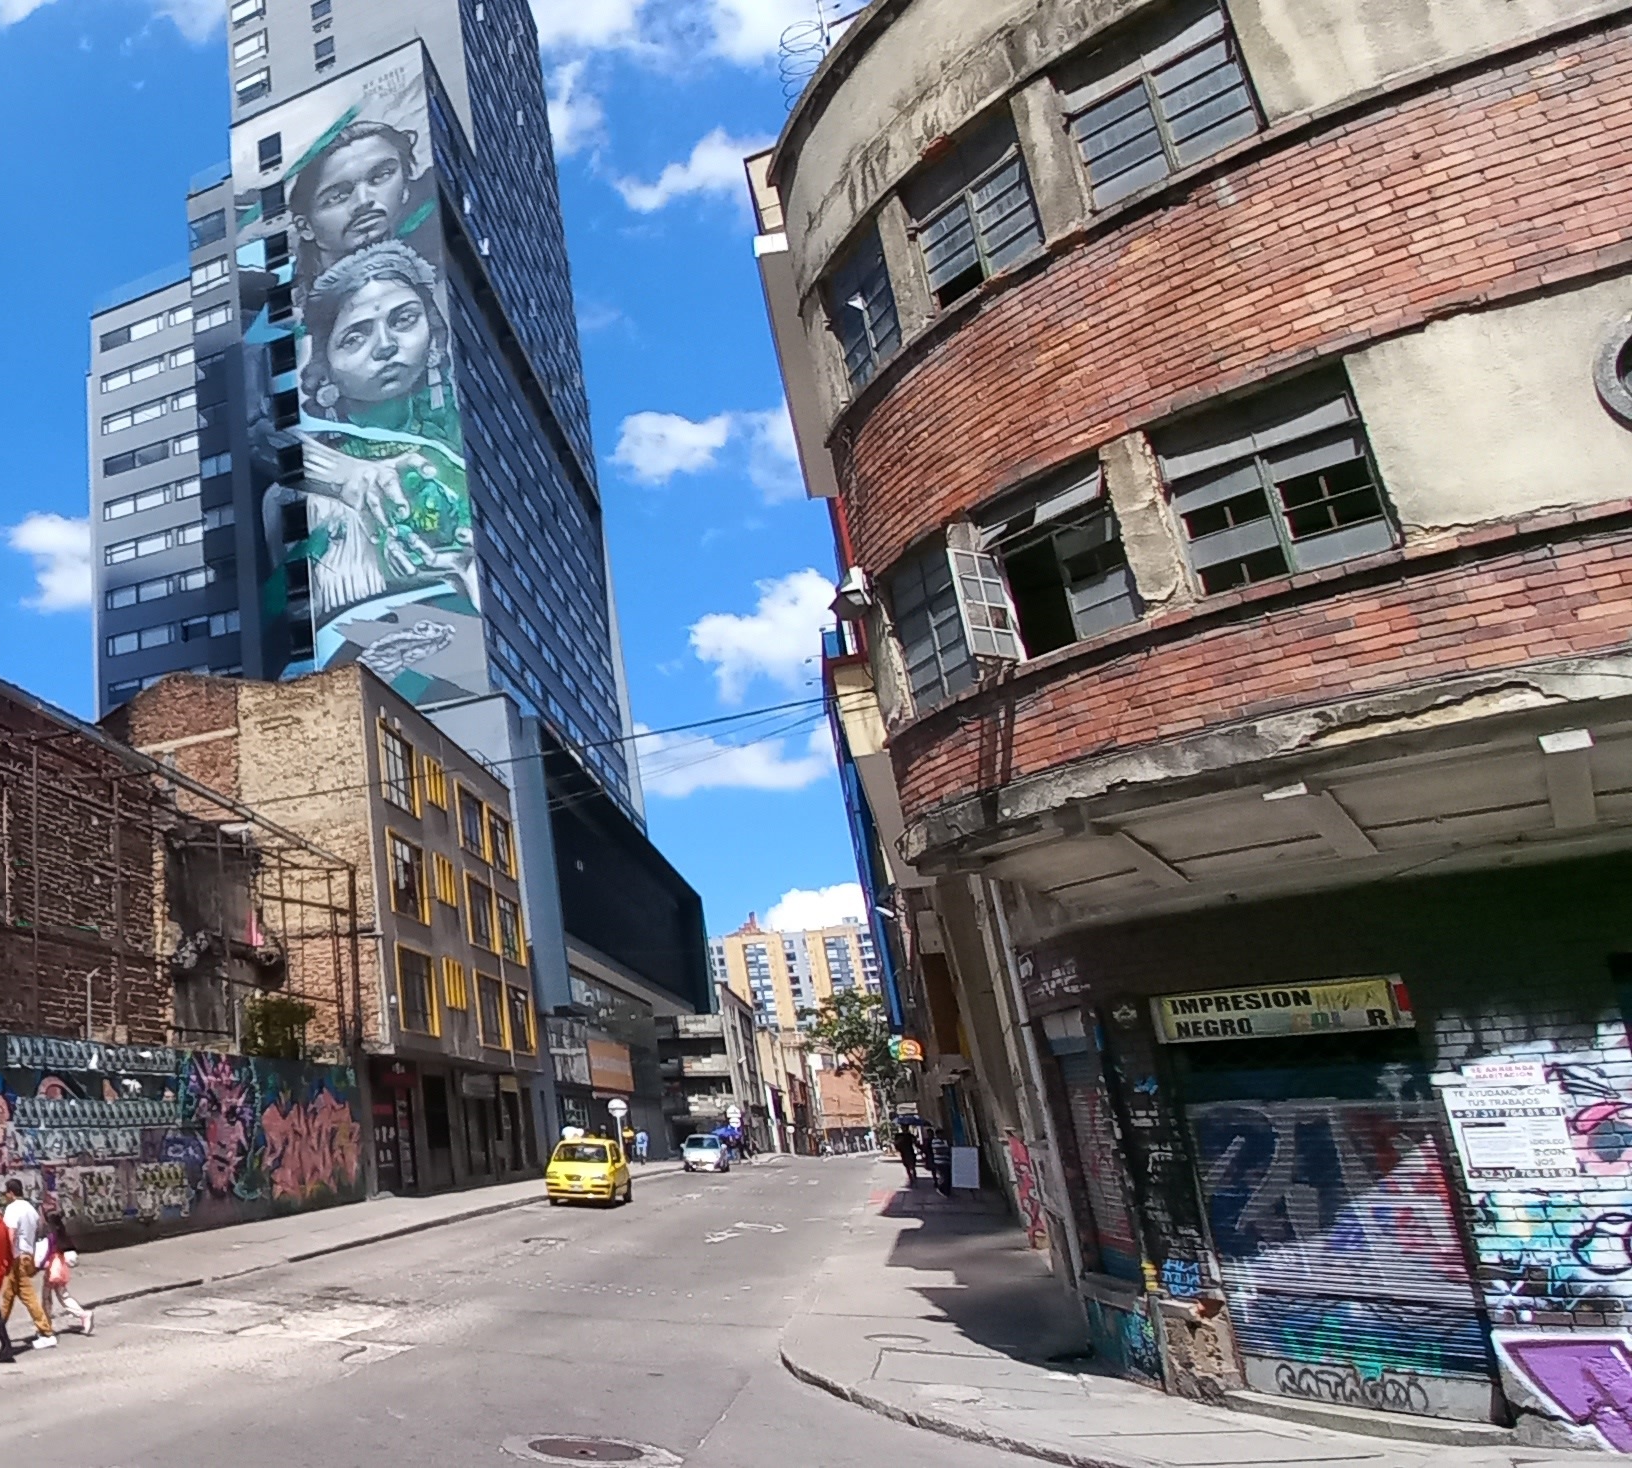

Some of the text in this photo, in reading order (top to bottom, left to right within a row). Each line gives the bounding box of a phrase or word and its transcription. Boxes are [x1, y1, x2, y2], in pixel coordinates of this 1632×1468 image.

[1171, 989, 1313, 1016] IMPRESION
[1175, 1017, 1255, 1039] NEGRO
[1453, 1090, 1465, 1098] TE
[1527, 1088, 1551, 1096] CON
[1467, 1097, 1541, 1107] TUS TRABAJOS
[1480, 1109, 1500, 1118] 317
[1527, 1107, 1540, 1116] 81
